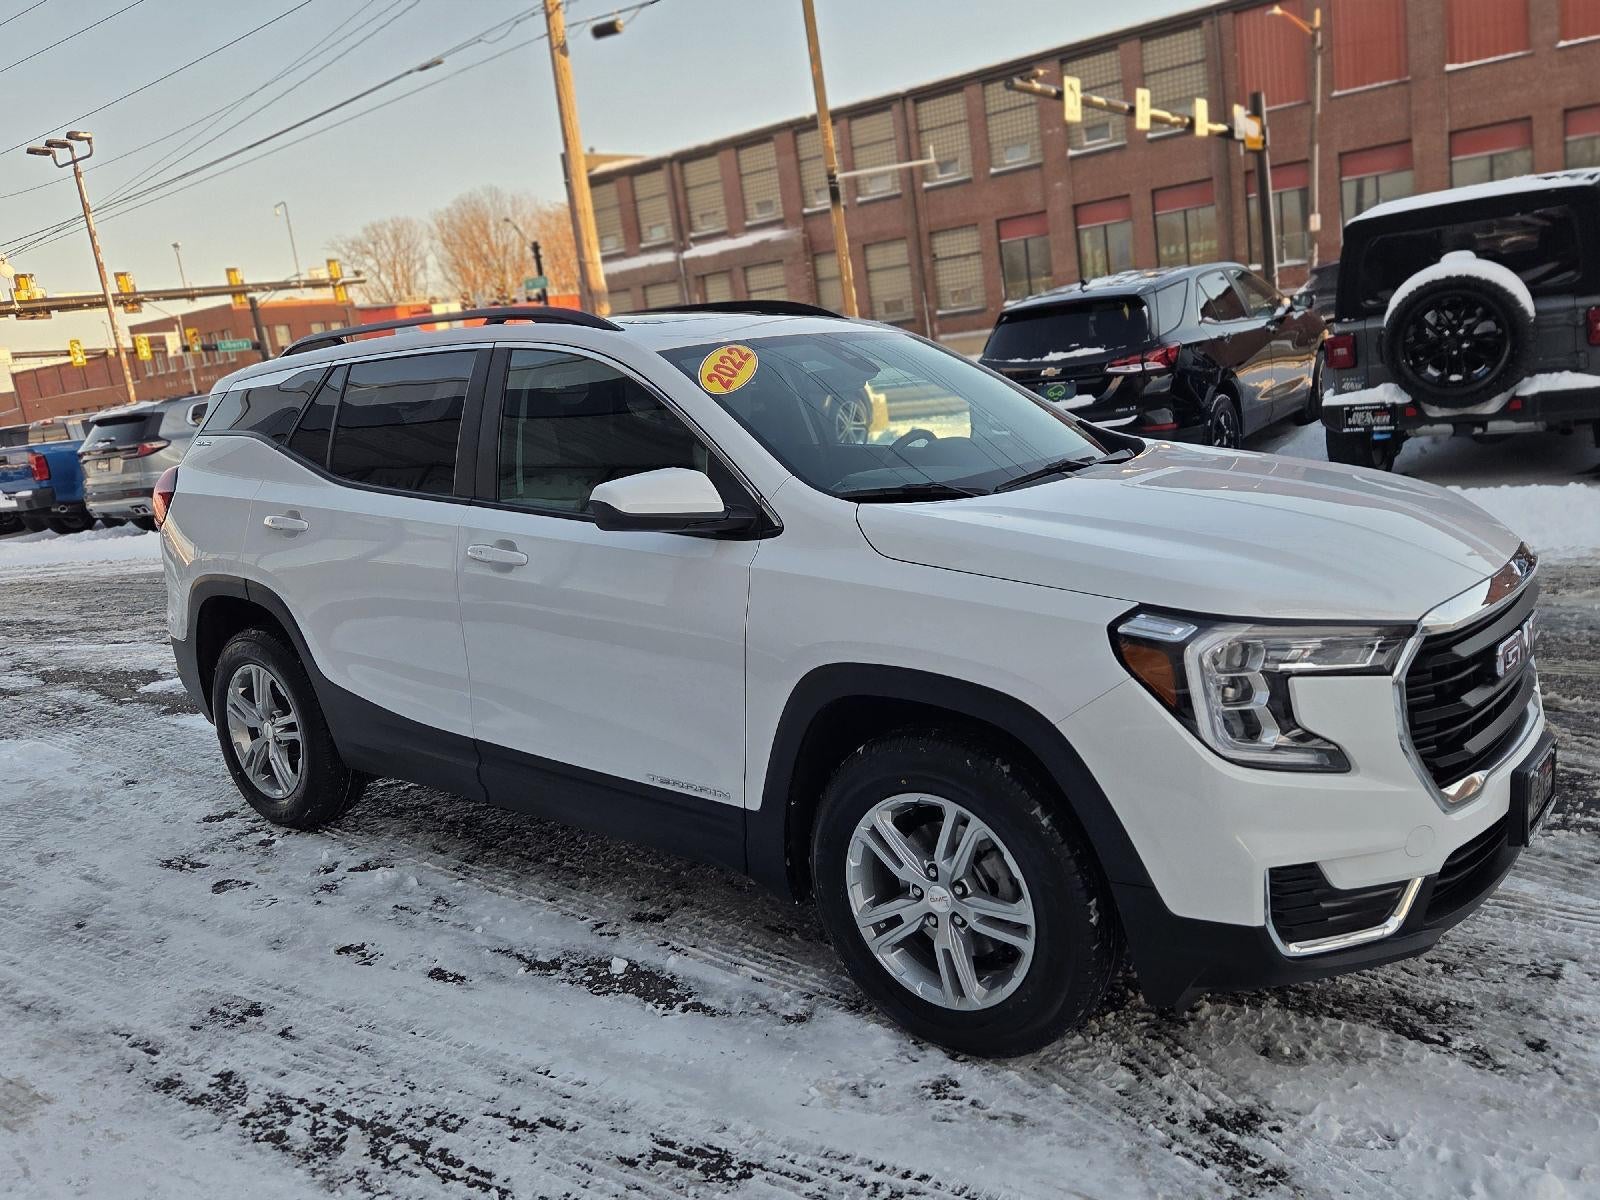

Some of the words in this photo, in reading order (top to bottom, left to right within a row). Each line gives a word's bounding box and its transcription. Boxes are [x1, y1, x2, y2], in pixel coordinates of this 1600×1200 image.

[221, 341, 249, 350] Liberty
[706, 347, 753, 391] 2022
[646, 772, 731, 801] TERRAIN
[929, 895, 949, 903] GMC
